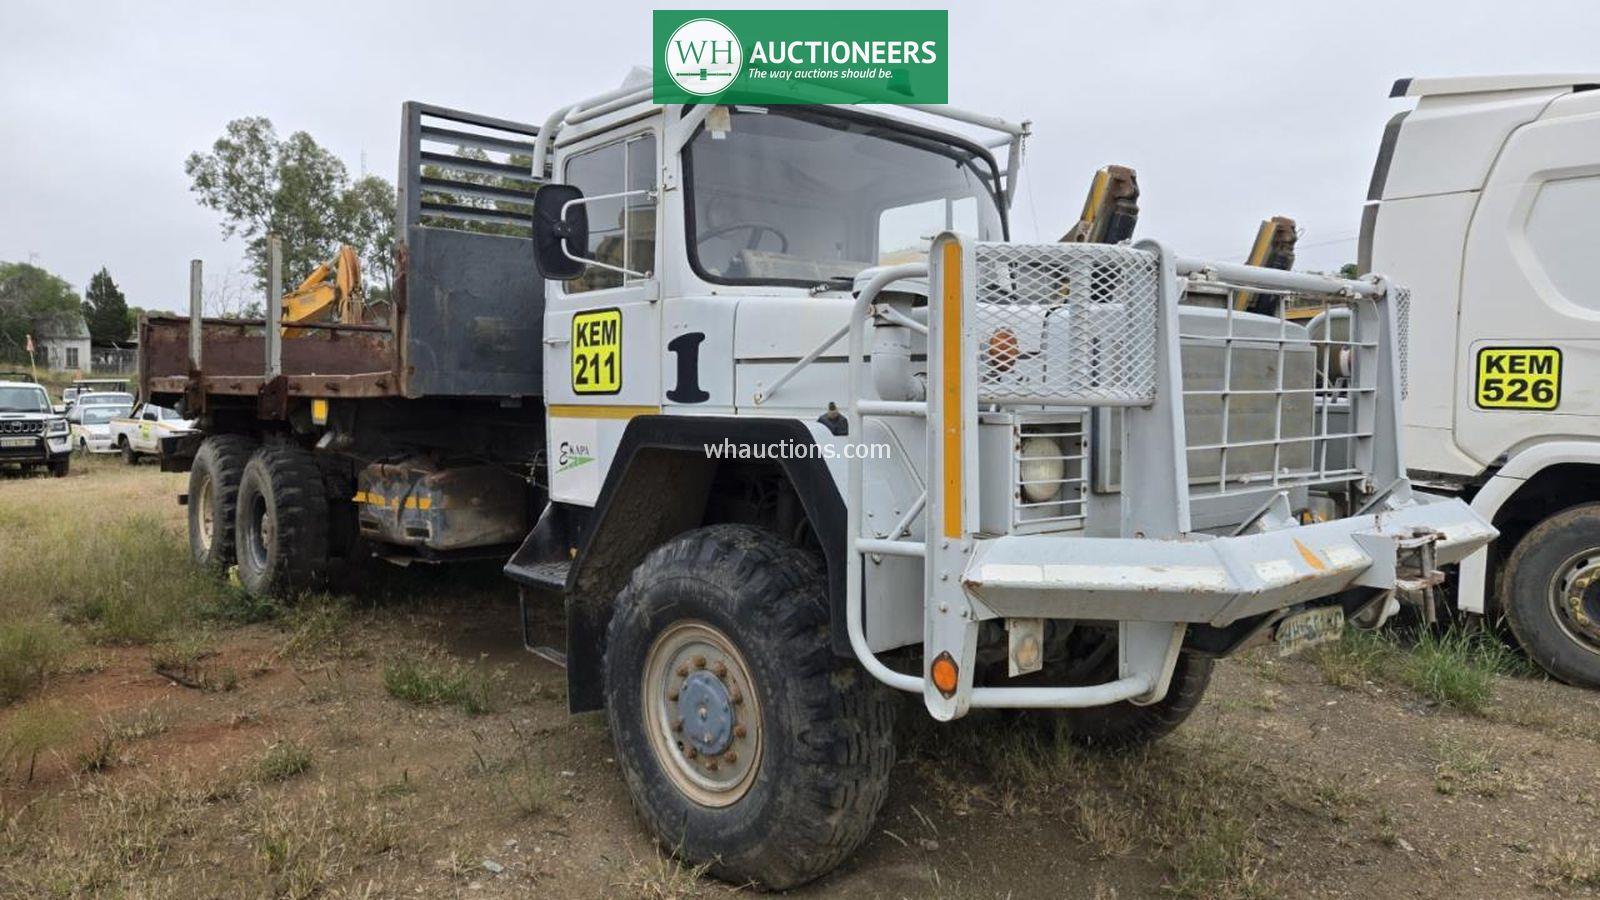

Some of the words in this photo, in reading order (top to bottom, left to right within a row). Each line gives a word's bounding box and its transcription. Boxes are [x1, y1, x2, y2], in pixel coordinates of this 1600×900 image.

[576, 320, 617, 347] KEM
[575, 351, 615, 385] 211
[666, 332, 710, 404] 1
[1485, 354, 1553, 375] KEM
[1482, 378, 1554, 403] 526
